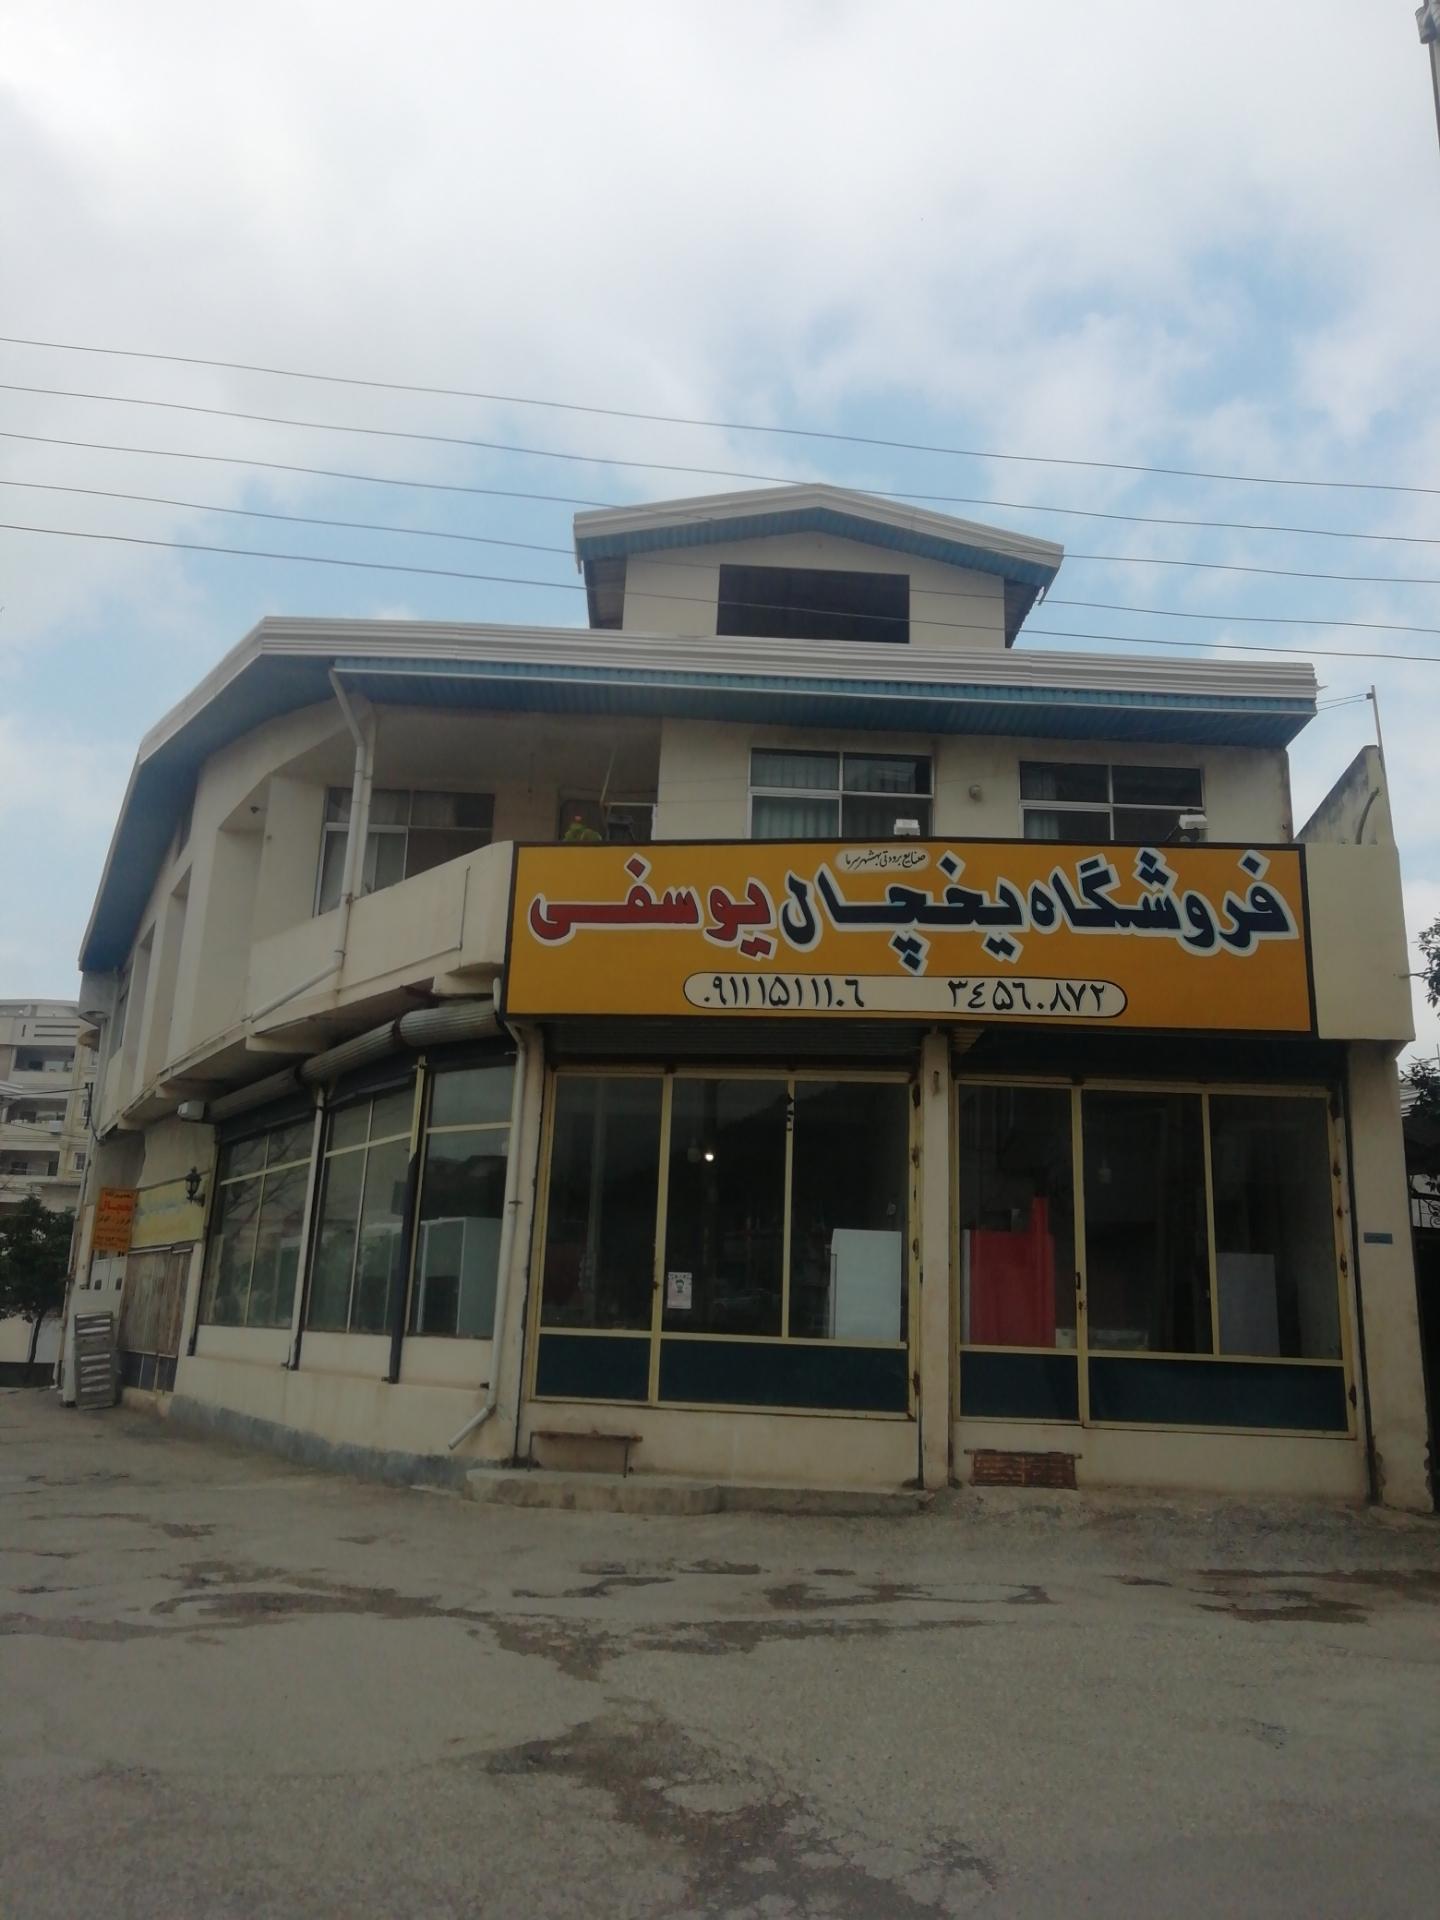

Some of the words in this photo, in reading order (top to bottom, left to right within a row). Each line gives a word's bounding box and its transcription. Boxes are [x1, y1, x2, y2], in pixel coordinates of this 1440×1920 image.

[528, 855, 774, 957] یوسفی
[902, 851, 926, 869] صنایع
[1029, 849, 1295, 952] فروشگاه
[779, 855, 1026, 973] یخچال
